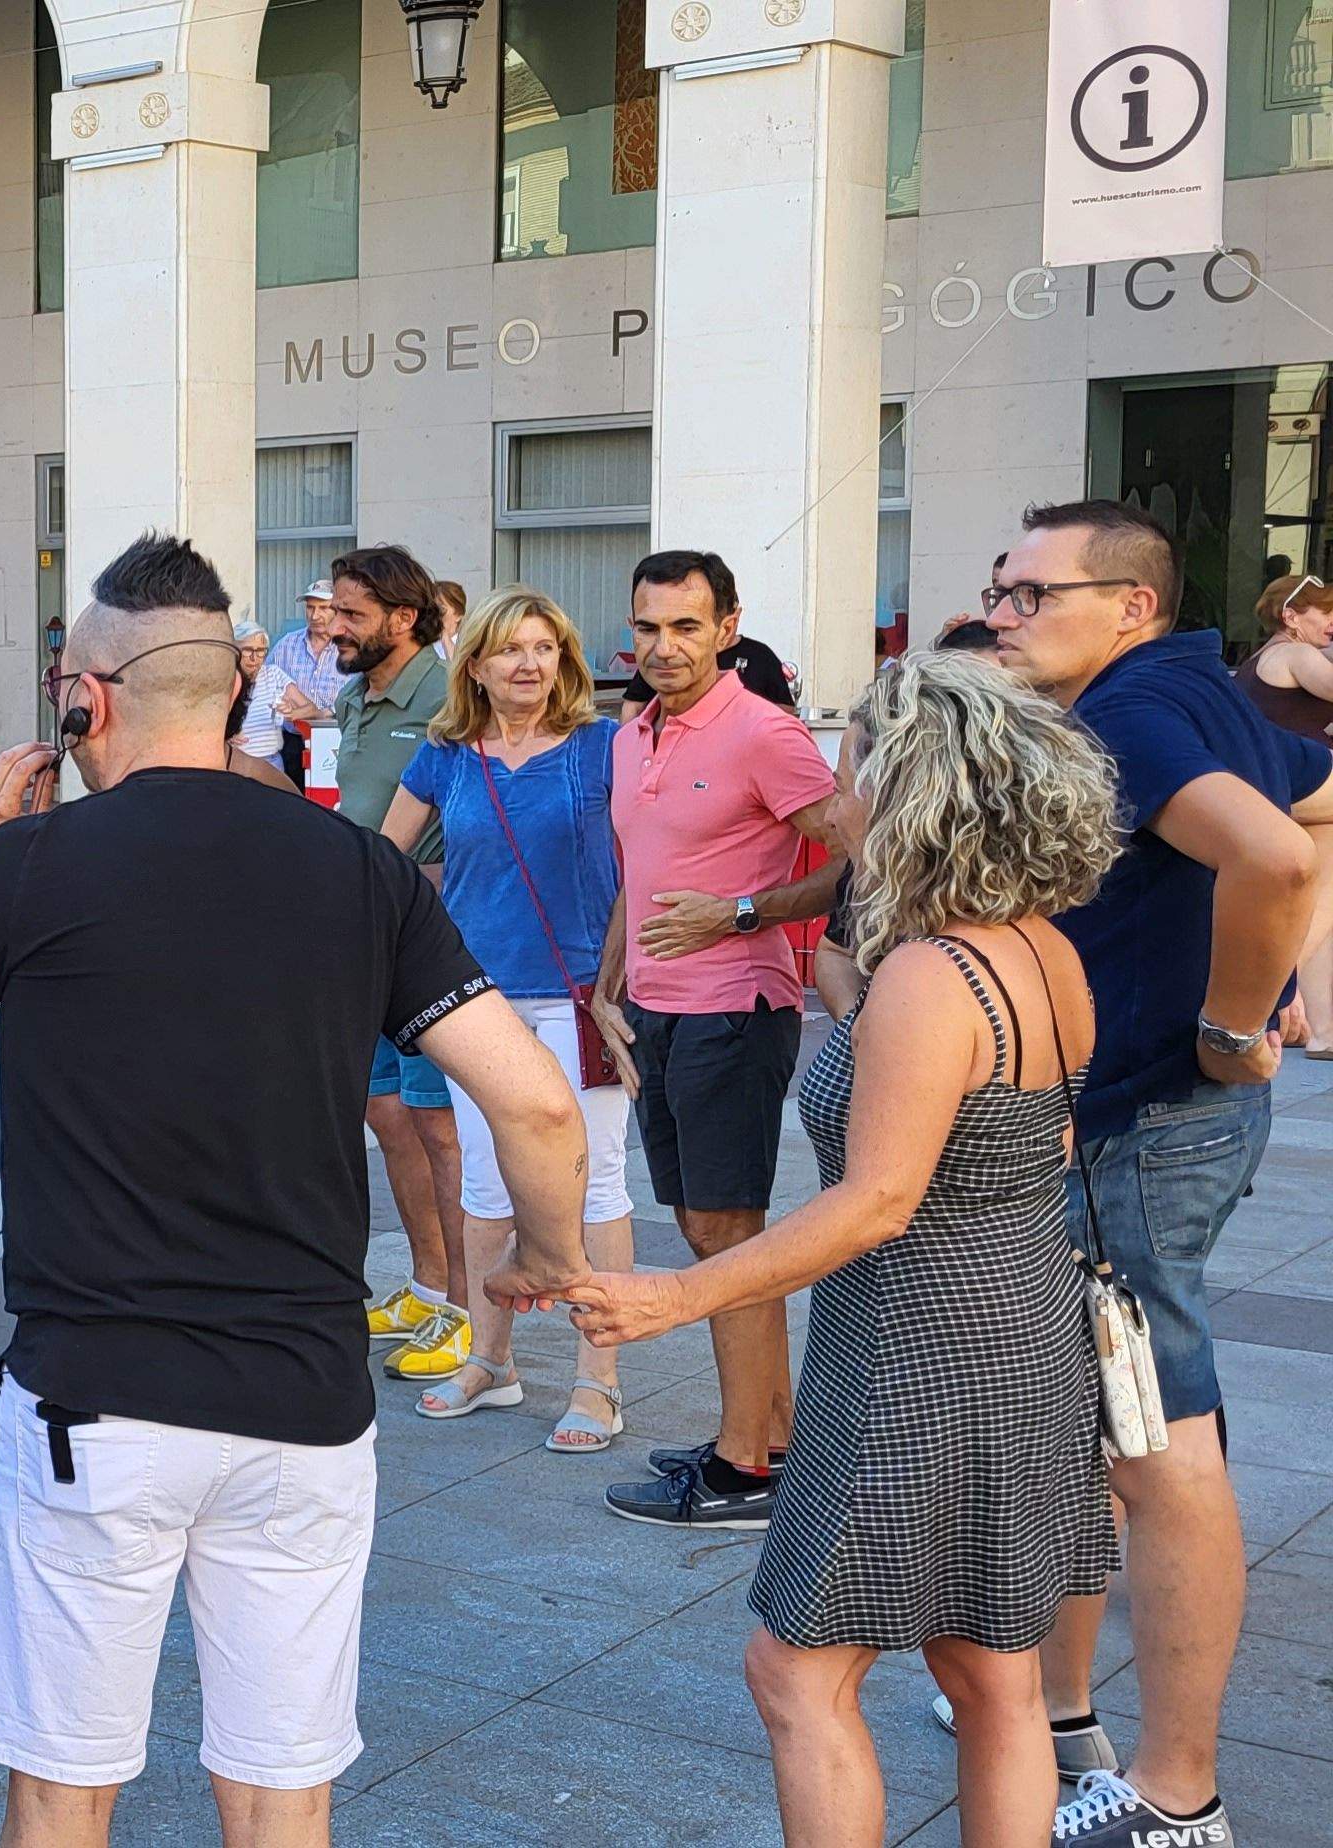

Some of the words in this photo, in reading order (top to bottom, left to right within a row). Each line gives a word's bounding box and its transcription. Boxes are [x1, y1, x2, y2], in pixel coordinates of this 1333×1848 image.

[1071, 183, 1202, 205] www.huescaturismo.com
[284, 317, 541, 385] MUSEO
[398, 990, 460, 1042] DIFFERENT
[463, 976, 486, 995] SAY
